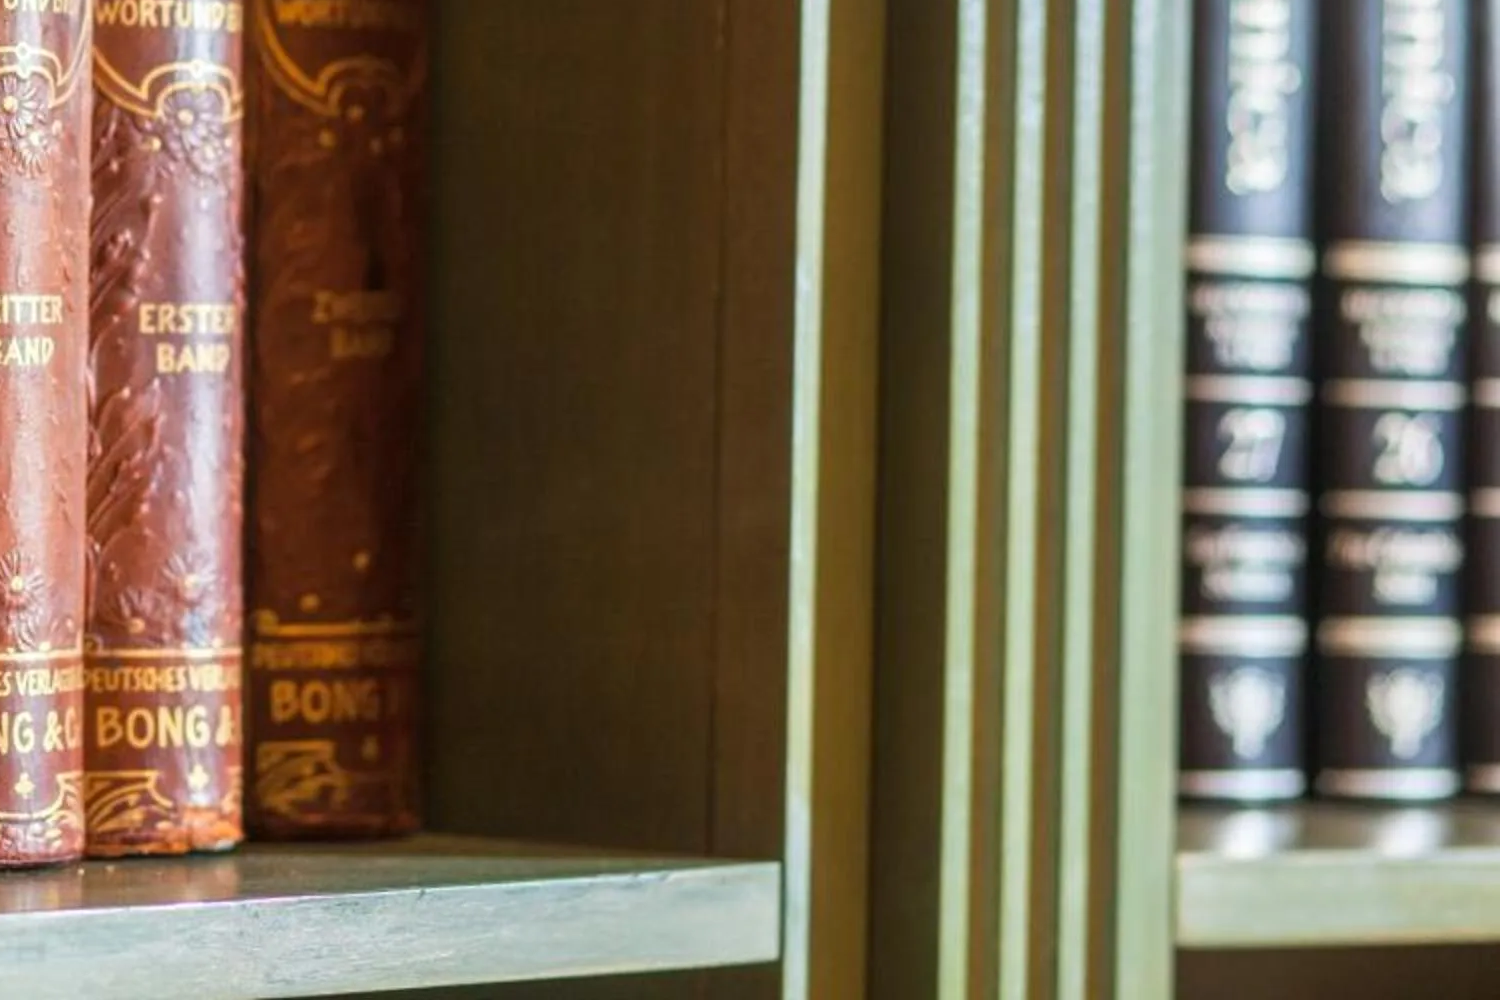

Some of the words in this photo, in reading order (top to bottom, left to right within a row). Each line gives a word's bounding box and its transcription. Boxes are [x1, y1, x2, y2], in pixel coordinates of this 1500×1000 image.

[156, 343, 230, 374] BAND
[42, 710, 65, 753] &
[97, 705, 211, 749] BONG
